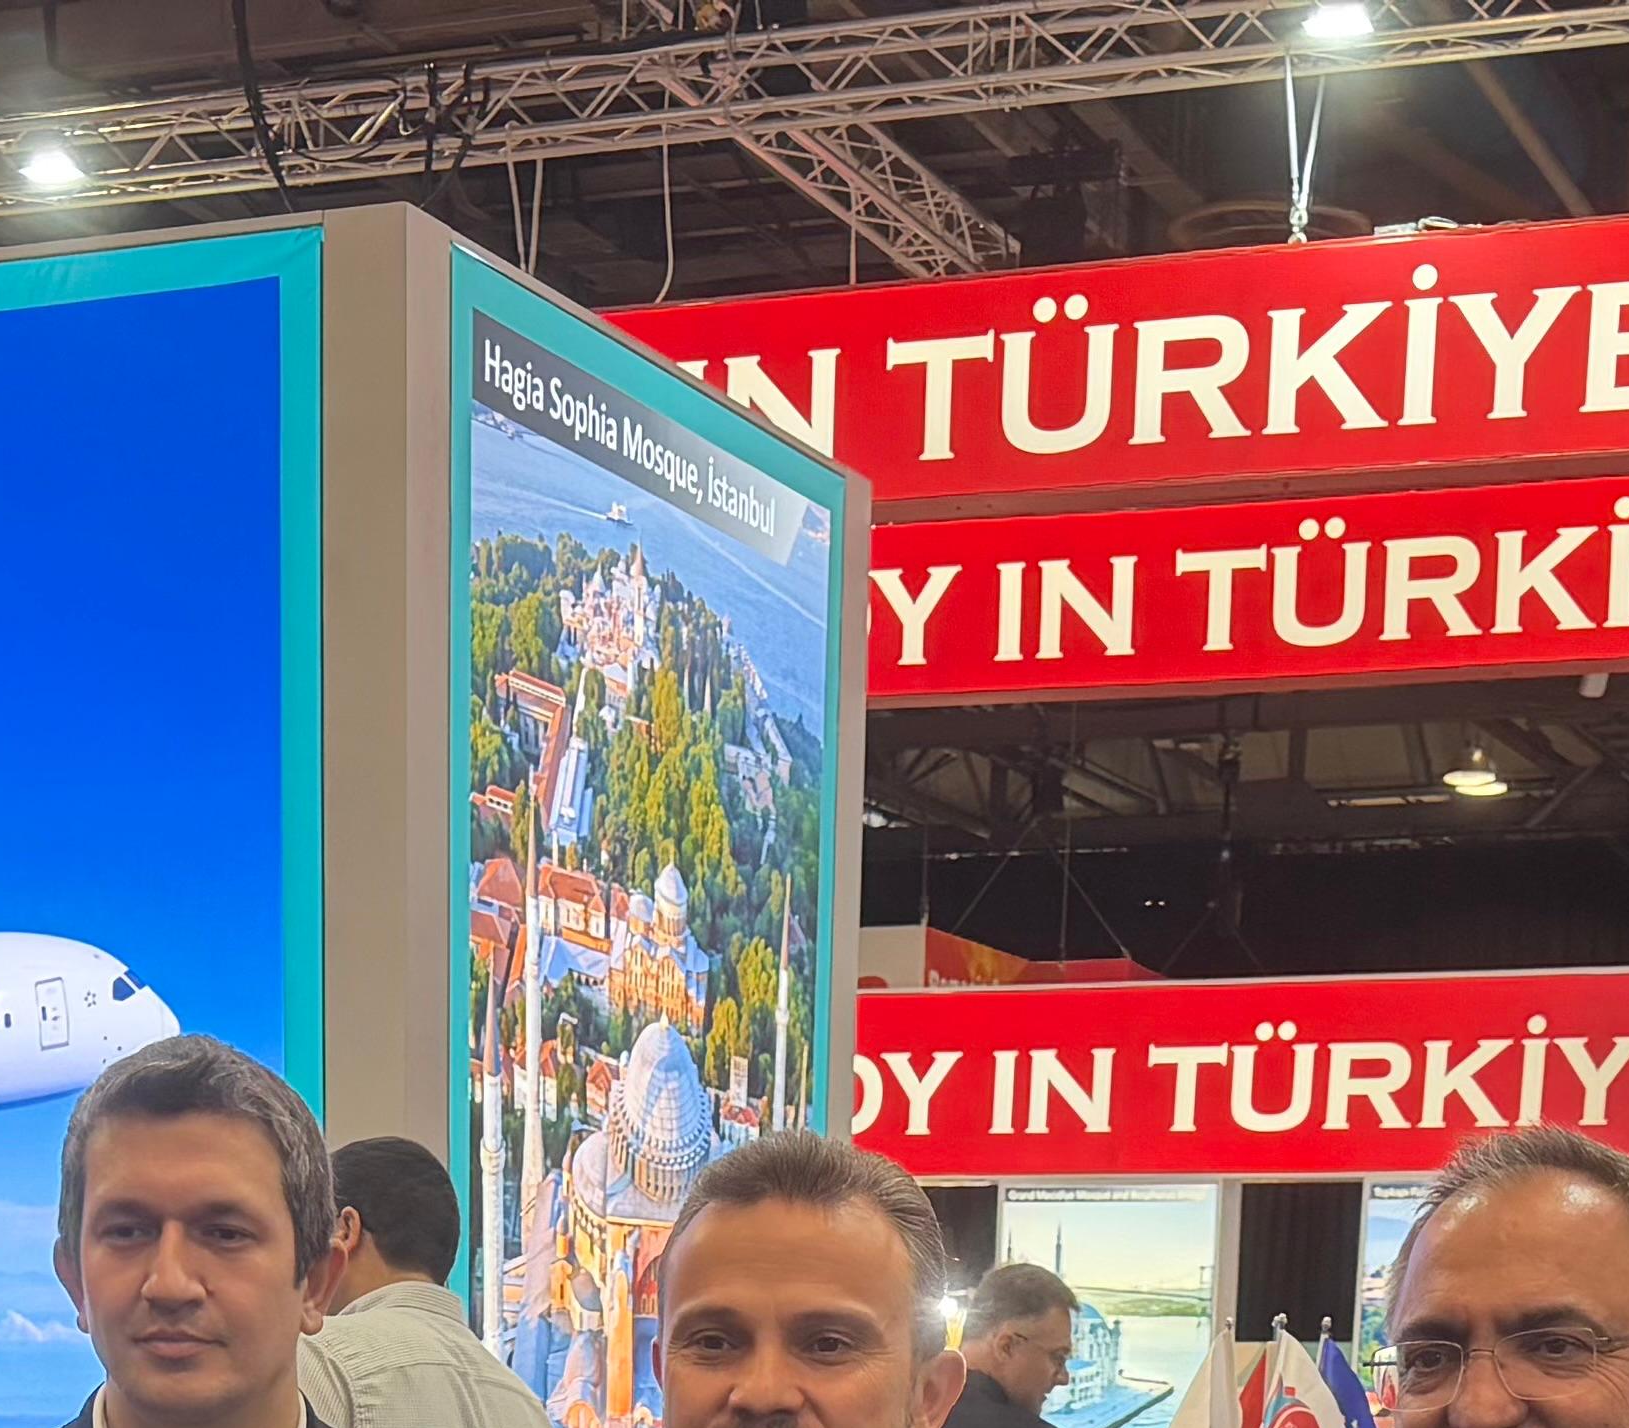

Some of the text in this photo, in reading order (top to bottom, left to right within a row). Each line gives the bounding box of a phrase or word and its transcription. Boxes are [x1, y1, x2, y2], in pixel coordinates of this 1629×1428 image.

[484, 339, 775, 537] Hagia Sophia Mosque, İstanbul
[677, 348, 841, 459] N
[866, 564, 962, 665] Y
[993, 556, 1136, 661] IN
[989, 1048, 1116, 1134] IN
